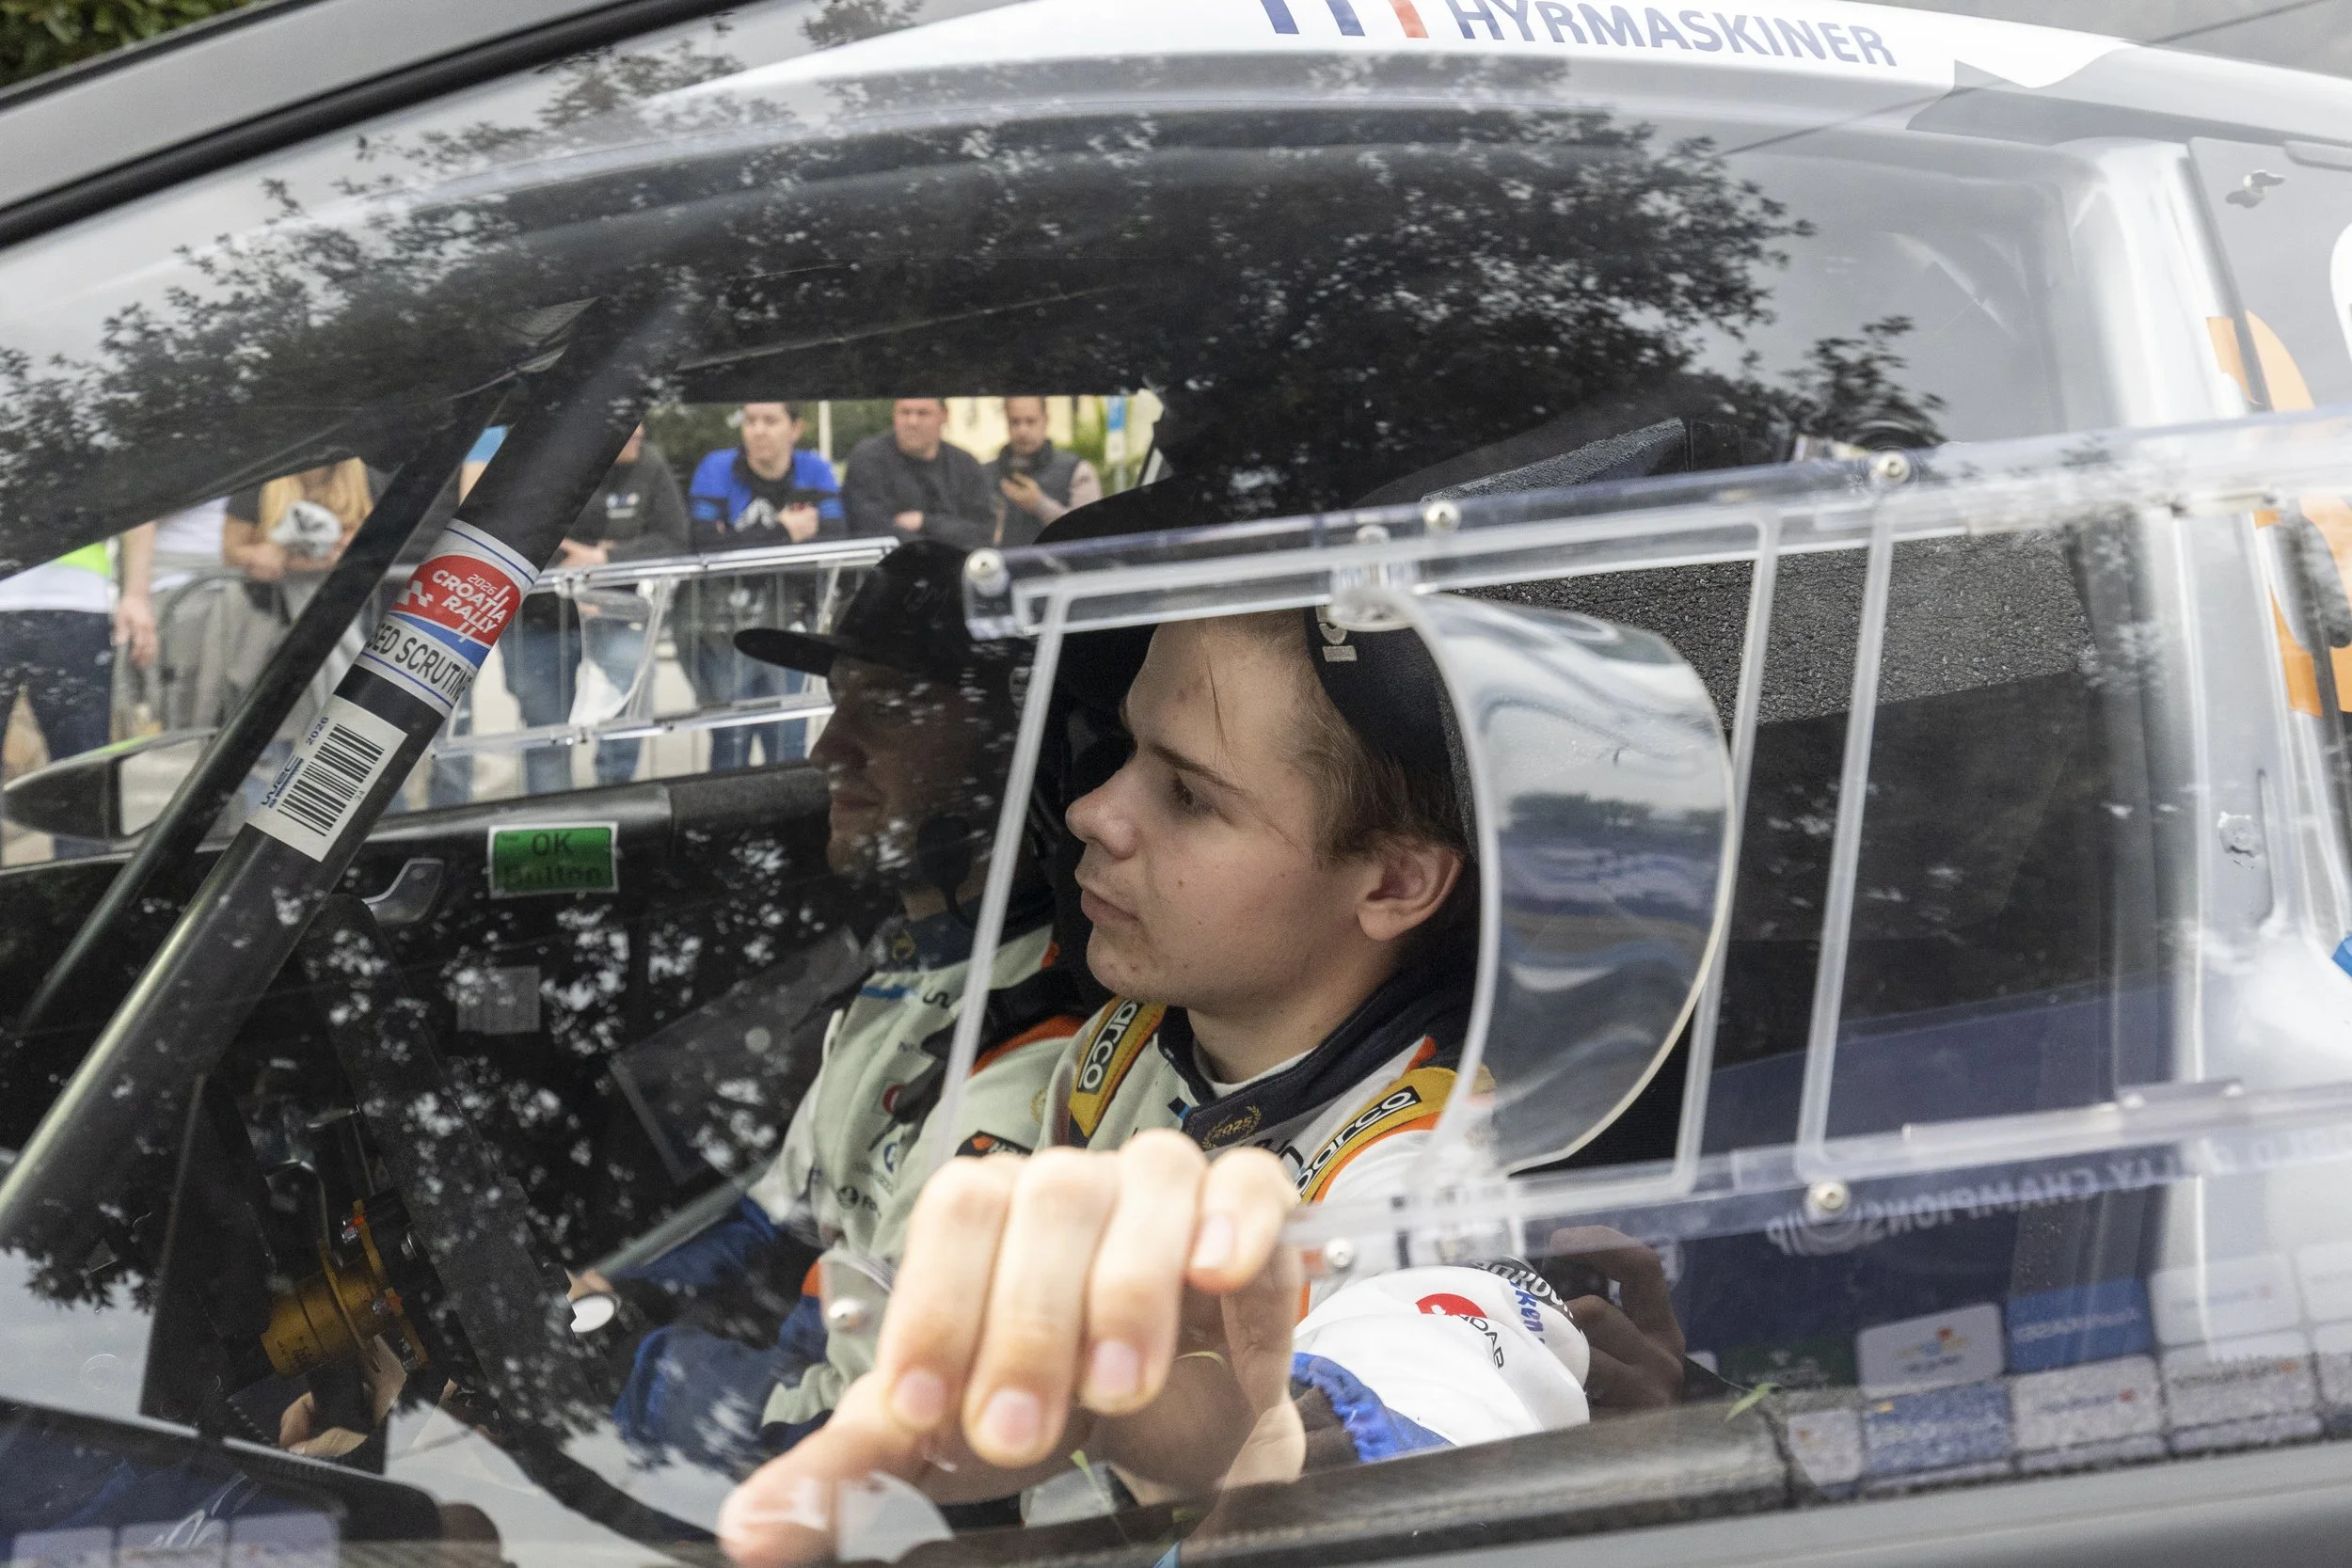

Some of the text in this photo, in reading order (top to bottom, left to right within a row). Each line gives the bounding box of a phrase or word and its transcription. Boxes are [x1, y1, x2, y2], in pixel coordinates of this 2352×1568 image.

[1445, 0, 1898, 67] HYRMASKINER
[432, 569, 504, 624] CROATIA
[467, 574, 498, 596] 2026
[441, 594, 498, 634] RALLY
[531, 832, 574, 857] OK
[1080, 1001, 1138, 1089] arco
[1295, 1091, 1414, 1194] parco
